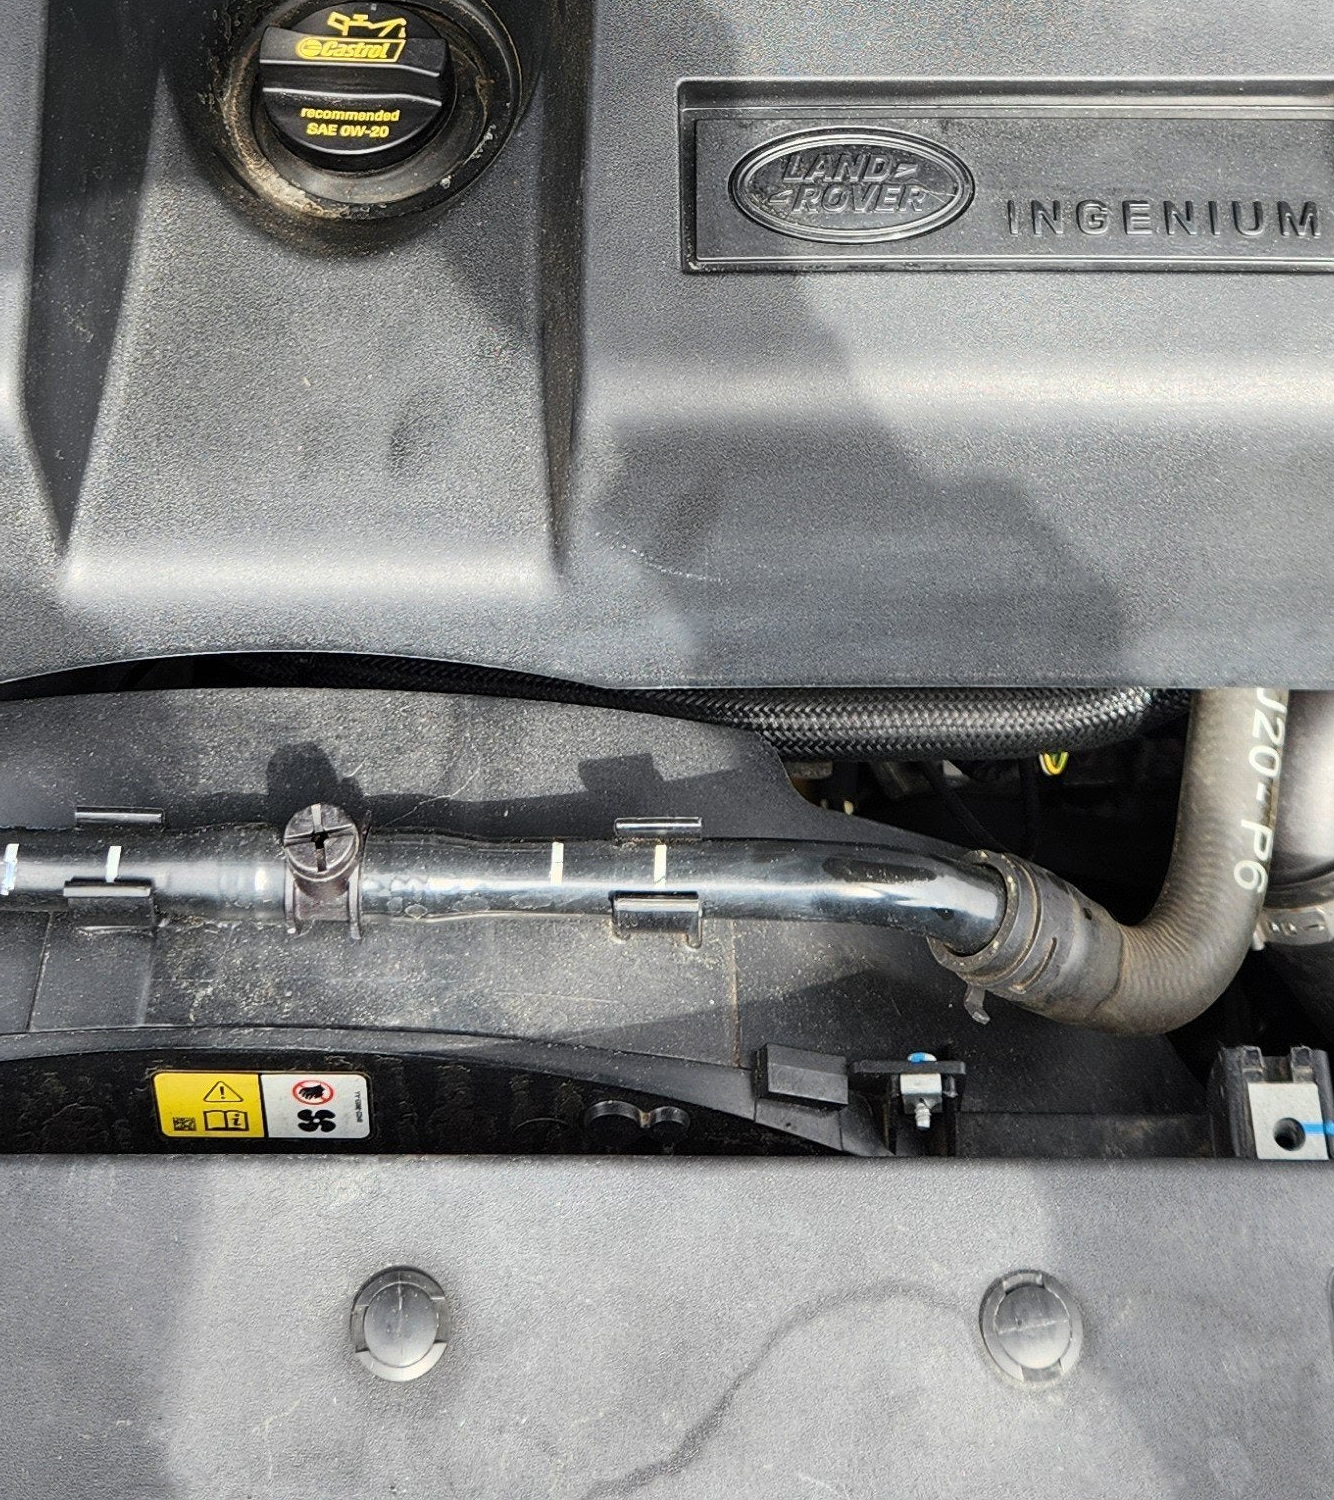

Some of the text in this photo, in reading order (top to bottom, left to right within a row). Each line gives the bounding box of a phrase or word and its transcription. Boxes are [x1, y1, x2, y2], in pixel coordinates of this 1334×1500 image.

[320, 41, 388, 59] Castrol
[300, 107, 400, 122] recommended
[306, 123, 390, 138] SAE 0W-20
[782, 152, 897, 184] LAND
[791, 183, 928, 215] ROVER
[1005, 198, 1323, 239] INGENIUM
